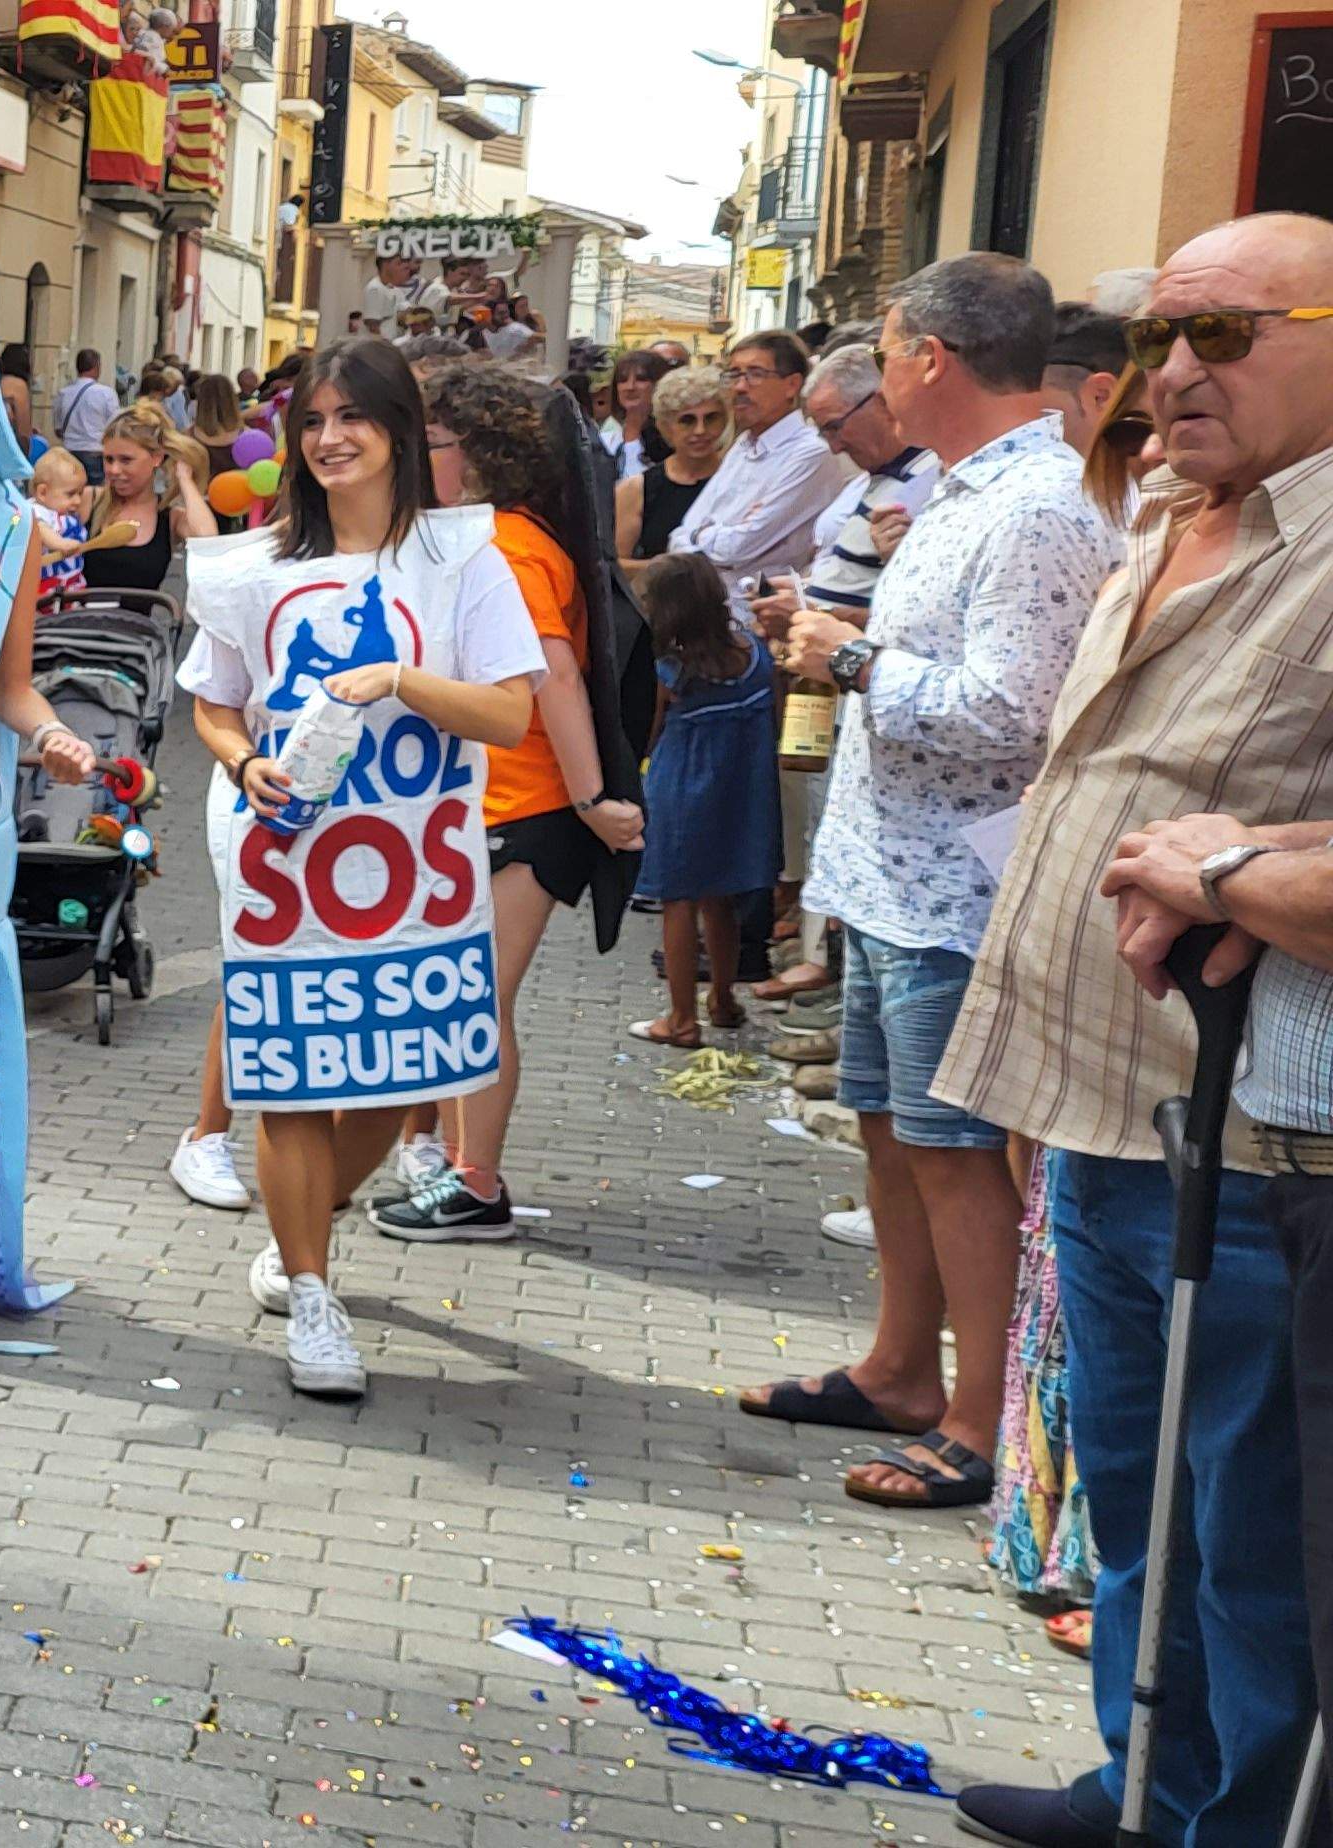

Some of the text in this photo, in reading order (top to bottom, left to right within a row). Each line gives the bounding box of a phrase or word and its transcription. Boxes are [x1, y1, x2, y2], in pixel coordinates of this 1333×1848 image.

[376, 225, 516, 259] GRECIA
[234, 799, 475, 946] SOS
[226, 970, 281, 1027] SI
[289, 968, 364, 1025] ES
[229, 1011, 500, 1093] ES BUENO
